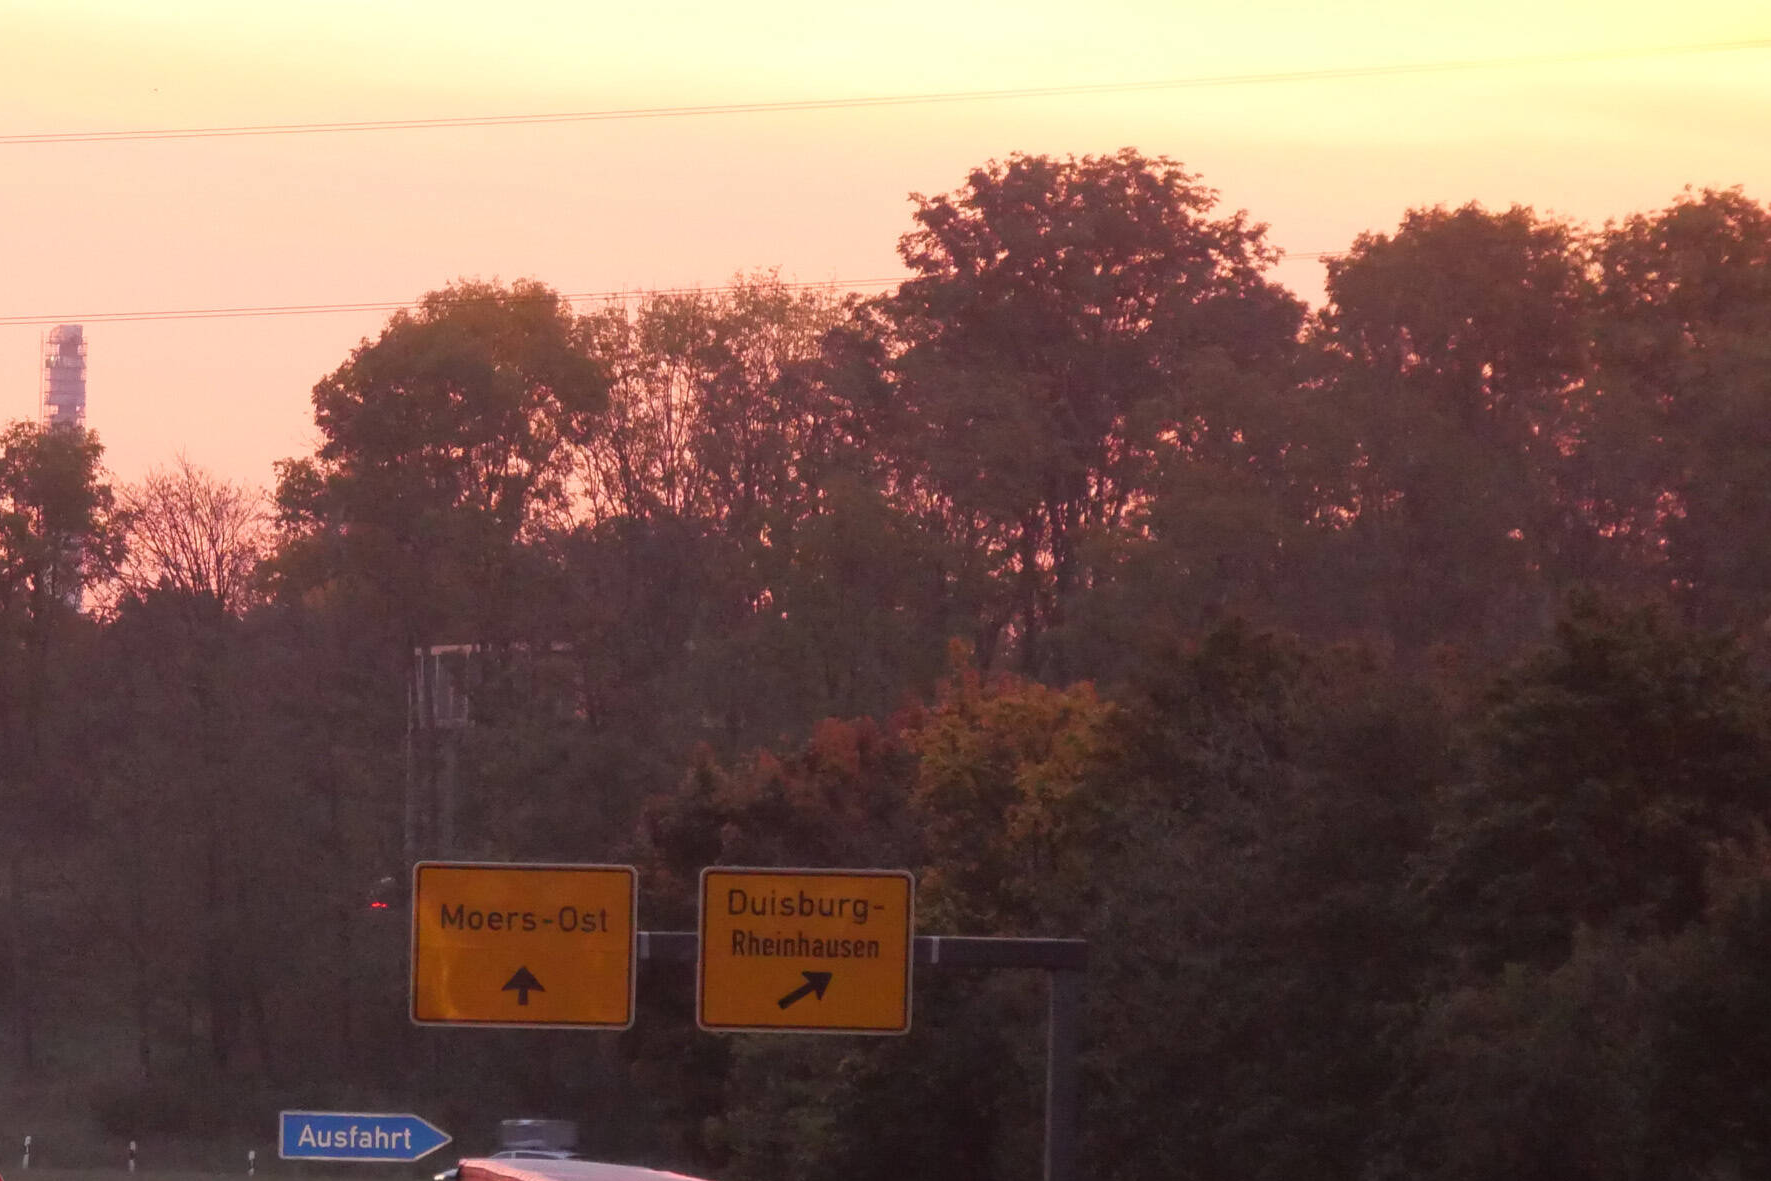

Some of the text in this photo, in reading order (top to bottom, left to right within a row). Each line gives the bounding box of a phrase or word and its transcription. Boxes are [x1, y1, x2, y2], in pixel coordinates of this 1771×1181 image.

[439, 903, 609, 933] Moers-Ost
[728, 888, 885, 925] Duisburg-
[731, 930, 881, 958] Rheinhausen
[297, 1123, 412, 1150] Ausfahrt
